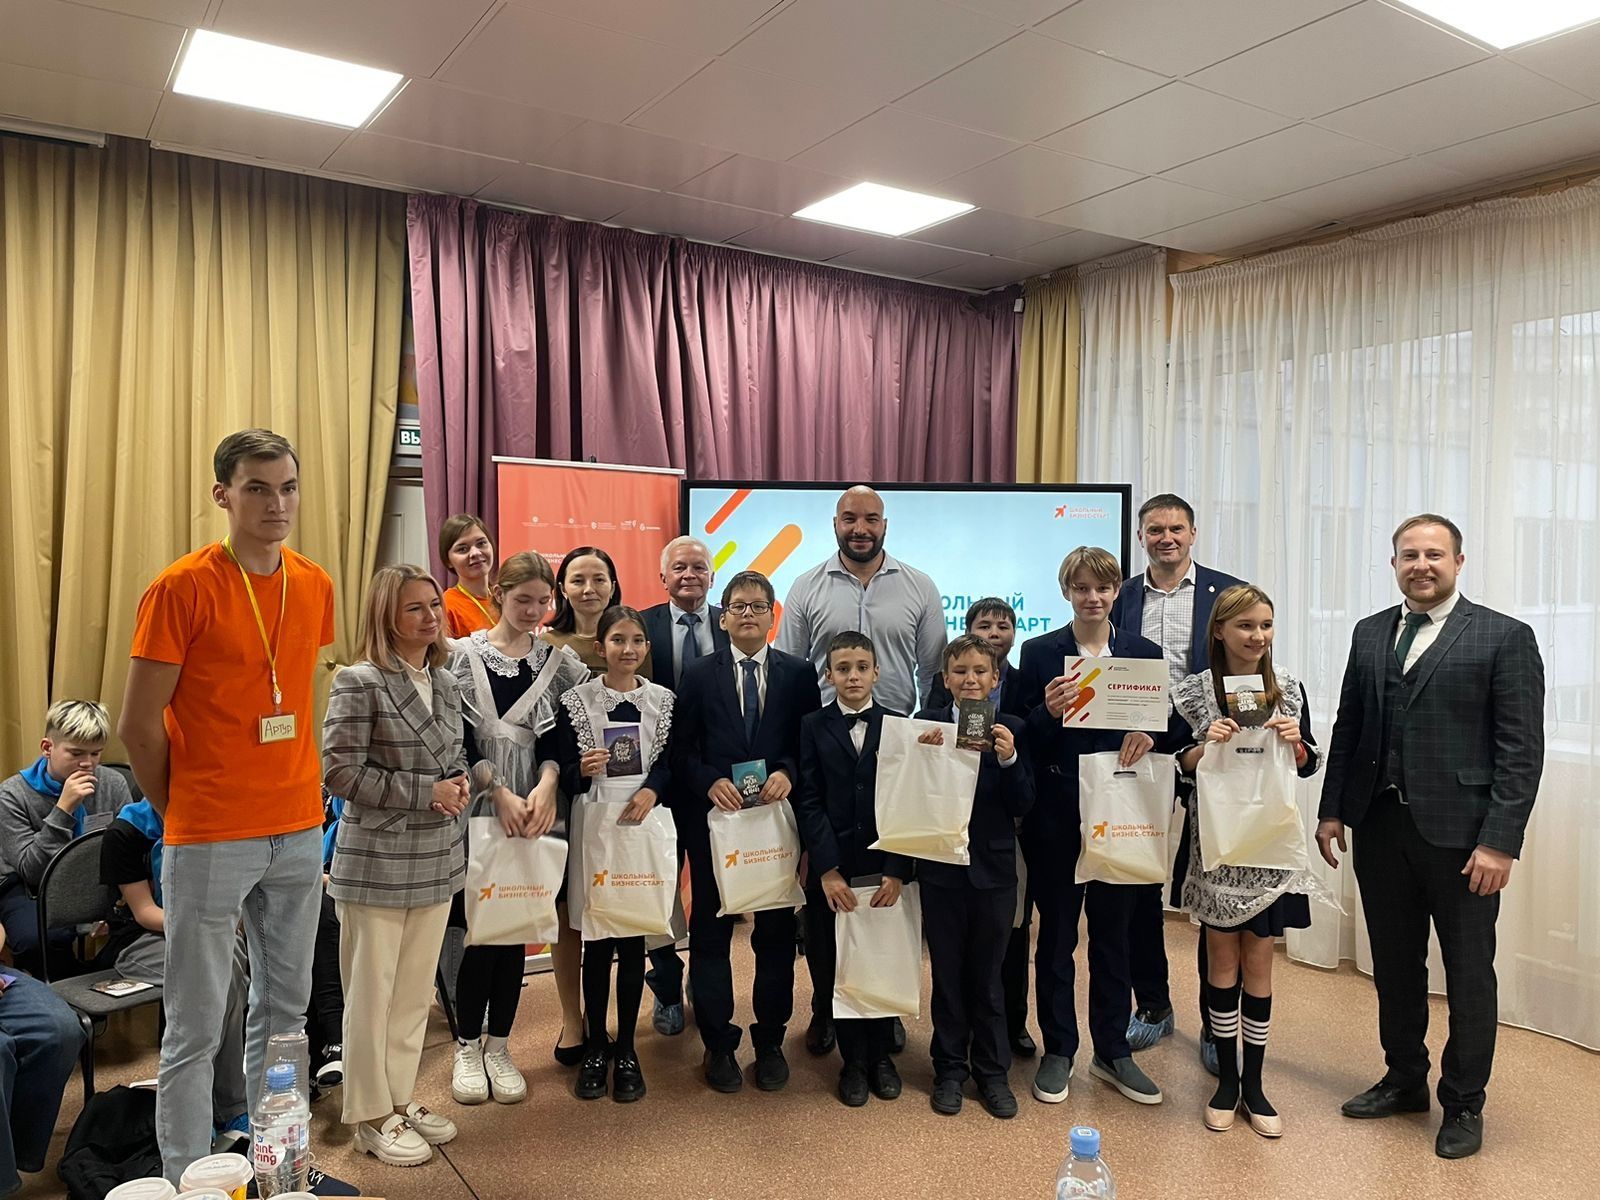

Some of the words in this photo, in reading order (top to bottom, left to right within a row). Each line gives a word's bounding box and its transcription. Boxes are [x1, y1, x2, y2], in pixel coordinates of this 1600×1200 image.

[1107, 683, 1161, 692] СЕРТИФИКАТ
[265, 720, 292, 738] Артур
[1111, 823, 1154, 831] ШКОЛЬНЫЙ
[742, 846, 784, 858] ШКОЛЬНЫЙ
[743, 852, 793, 865] БИЗНЕС-СТАРТ
[611, 872, 656, 880] ШКОЛЬНЫЙ
[498, 884, 544, 892] ШКОЛЬНЫЙ
[498, 890, 553, 899] БИЗНЕС-СТАРТ
[255, 1144, 273, 1154] aint
